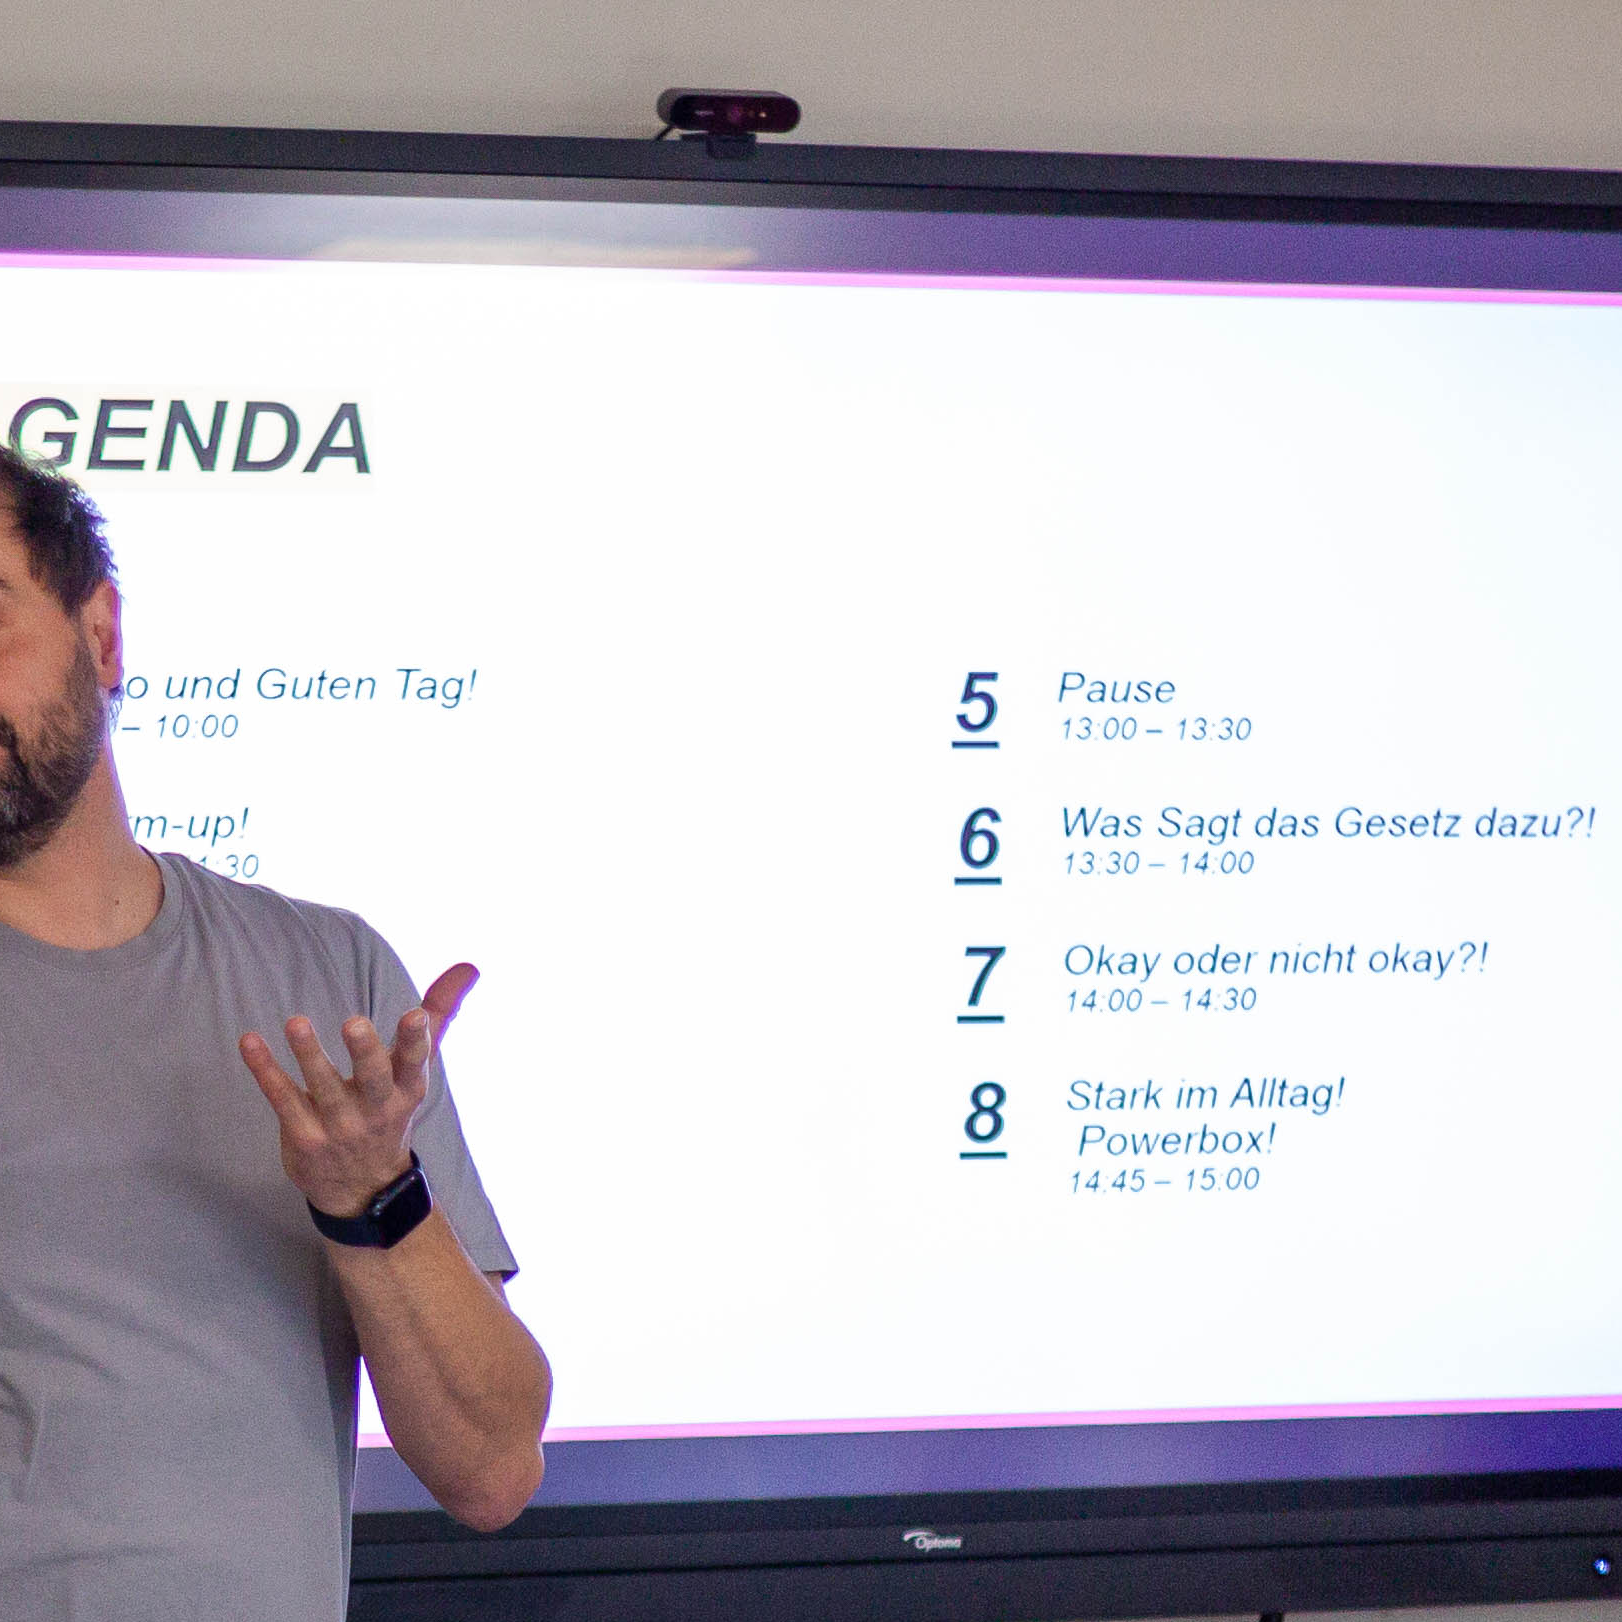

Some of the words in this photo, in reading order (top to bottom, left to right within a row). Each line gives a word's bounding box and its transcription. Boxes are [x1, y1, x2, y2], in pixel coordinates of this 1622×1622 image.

[165, 667, 242, 701] und
[256, 667, 377, 701] Guten
[396, 667, 480, 711] Tag!
[955, 671, 1001, 734] 5
[1057, 671, 1177, 705] Pause
[156, 713, 240, 740] 10:00
[1061, 716, 1139, 742] 13:00
[1177, 716, 1254, 743] 13:30
[130, 806, 250, 847] m-up!
[959, 806, 1004, 871] 6
[1063, 806, 1144, 840] Was
[1157, 806, 1243, 846] Sagt
[1254, 806, 1321, 840] das
[1334, 805, 1464, 839] Gesetz
[1475, 805, 1597, 839] dazu?!
[1064, 849, 1142, 876] 13:30
[1179, 849, 1256, 875] 14:00
[963, 945, 1007, 1009] 7
[1064, 944, 1162, 984] Okay
[1173, 943, 1259, 976] oder
[1269, 941, 1358, 976] nicht
[1368, 940, 1490, 981] okay?!
[1066, 987, 1144, 1013] 14:00
[1181, 986, 1258, 1013] 14:30
[963, 1081, 1009, 1144] 8
[1067, 1078, 1163, 1111] Stark
[1176, 1078, 1219, 1110] im
[1229, 1075, 1348, 1117] Alltag!
[1077, 1121, 1278, 1157] Powerbox!
[1070, 1167, 1146, 1195] 14:45
[1186, 1166, 1261, 1192] 15:00
